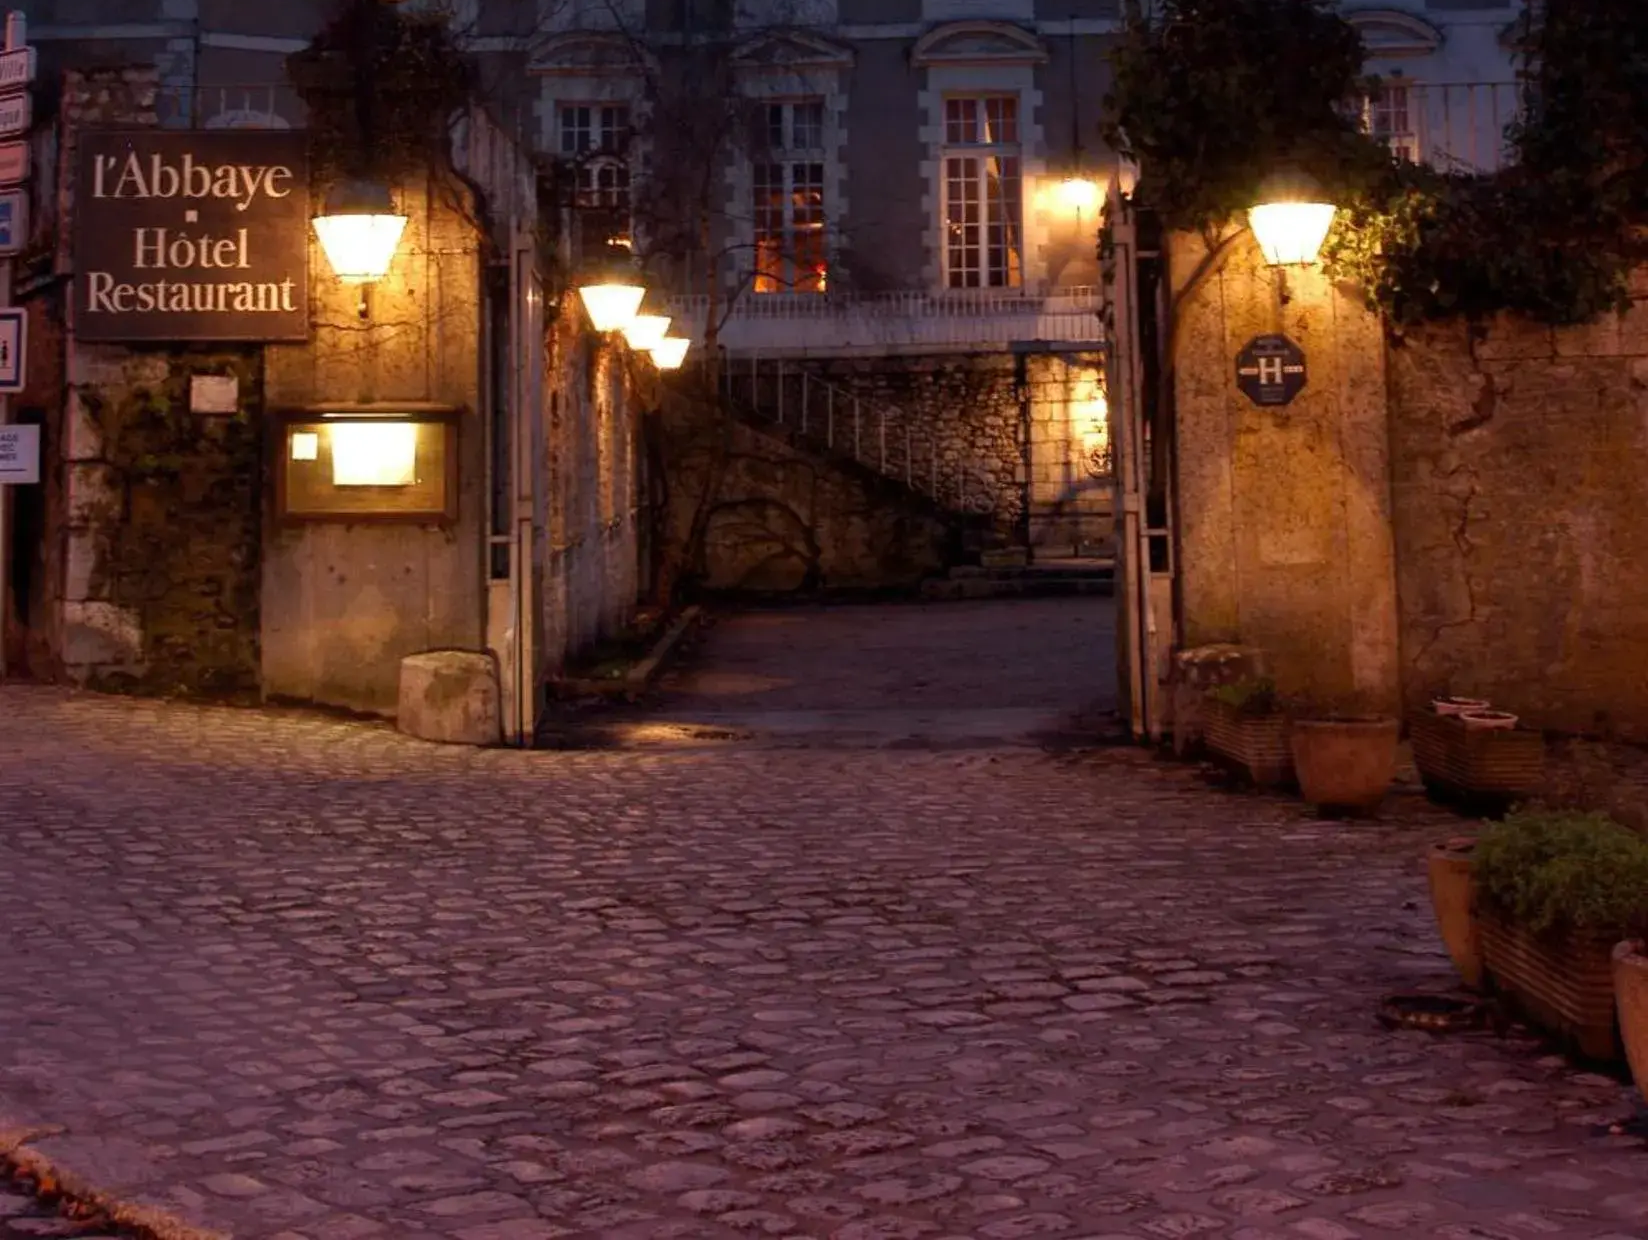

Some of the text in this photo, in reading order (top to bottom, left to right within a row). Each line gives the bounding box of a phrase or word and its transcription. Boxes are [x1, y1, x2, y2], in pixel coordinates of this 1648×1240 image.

[92, 151, 294, 211] l'Abbaye
[132, 226, 252, 269] Hôtel
[86, 271, 298, 314] Restaurant
[1257, 357, 1283, 385] H
